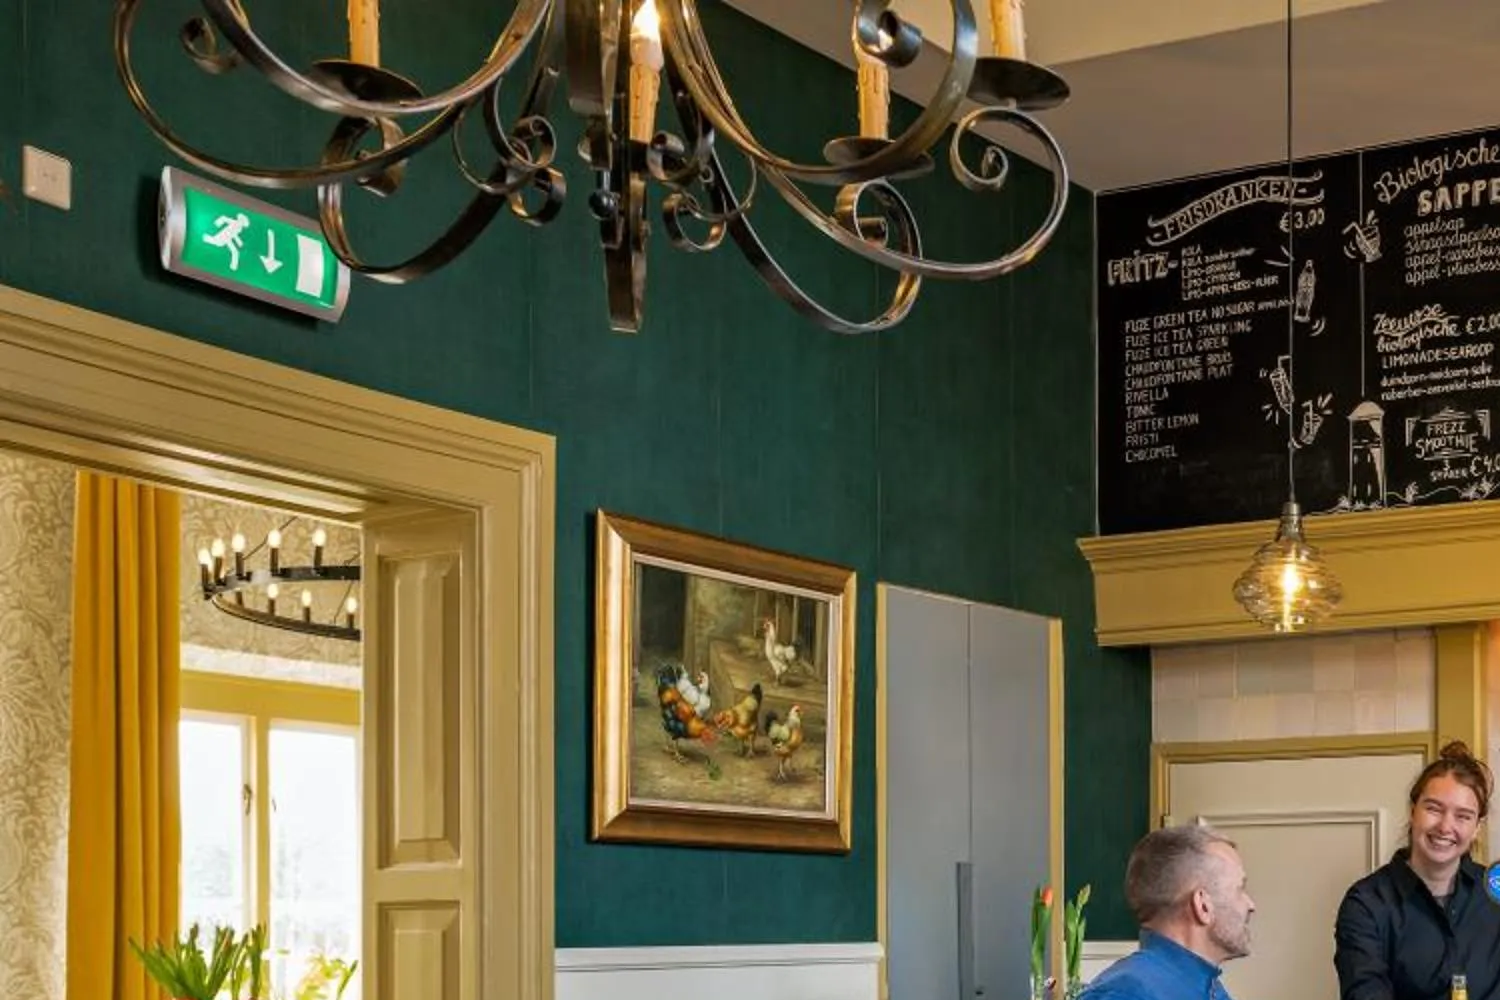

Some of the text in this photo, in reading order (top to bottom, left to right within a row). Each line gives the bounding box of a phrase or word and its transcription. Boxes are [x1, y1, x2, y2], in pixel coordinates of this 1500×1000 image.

[1164, 180, 1297, 239] FRISDRANKEN
[1187, 309, 1208, 323] TEA
[1172, 328, 1193, 341] TEA
[1172, 342, 1193, 356] TEA
[1415, 432, 1479, 459] SMOOTHIE
